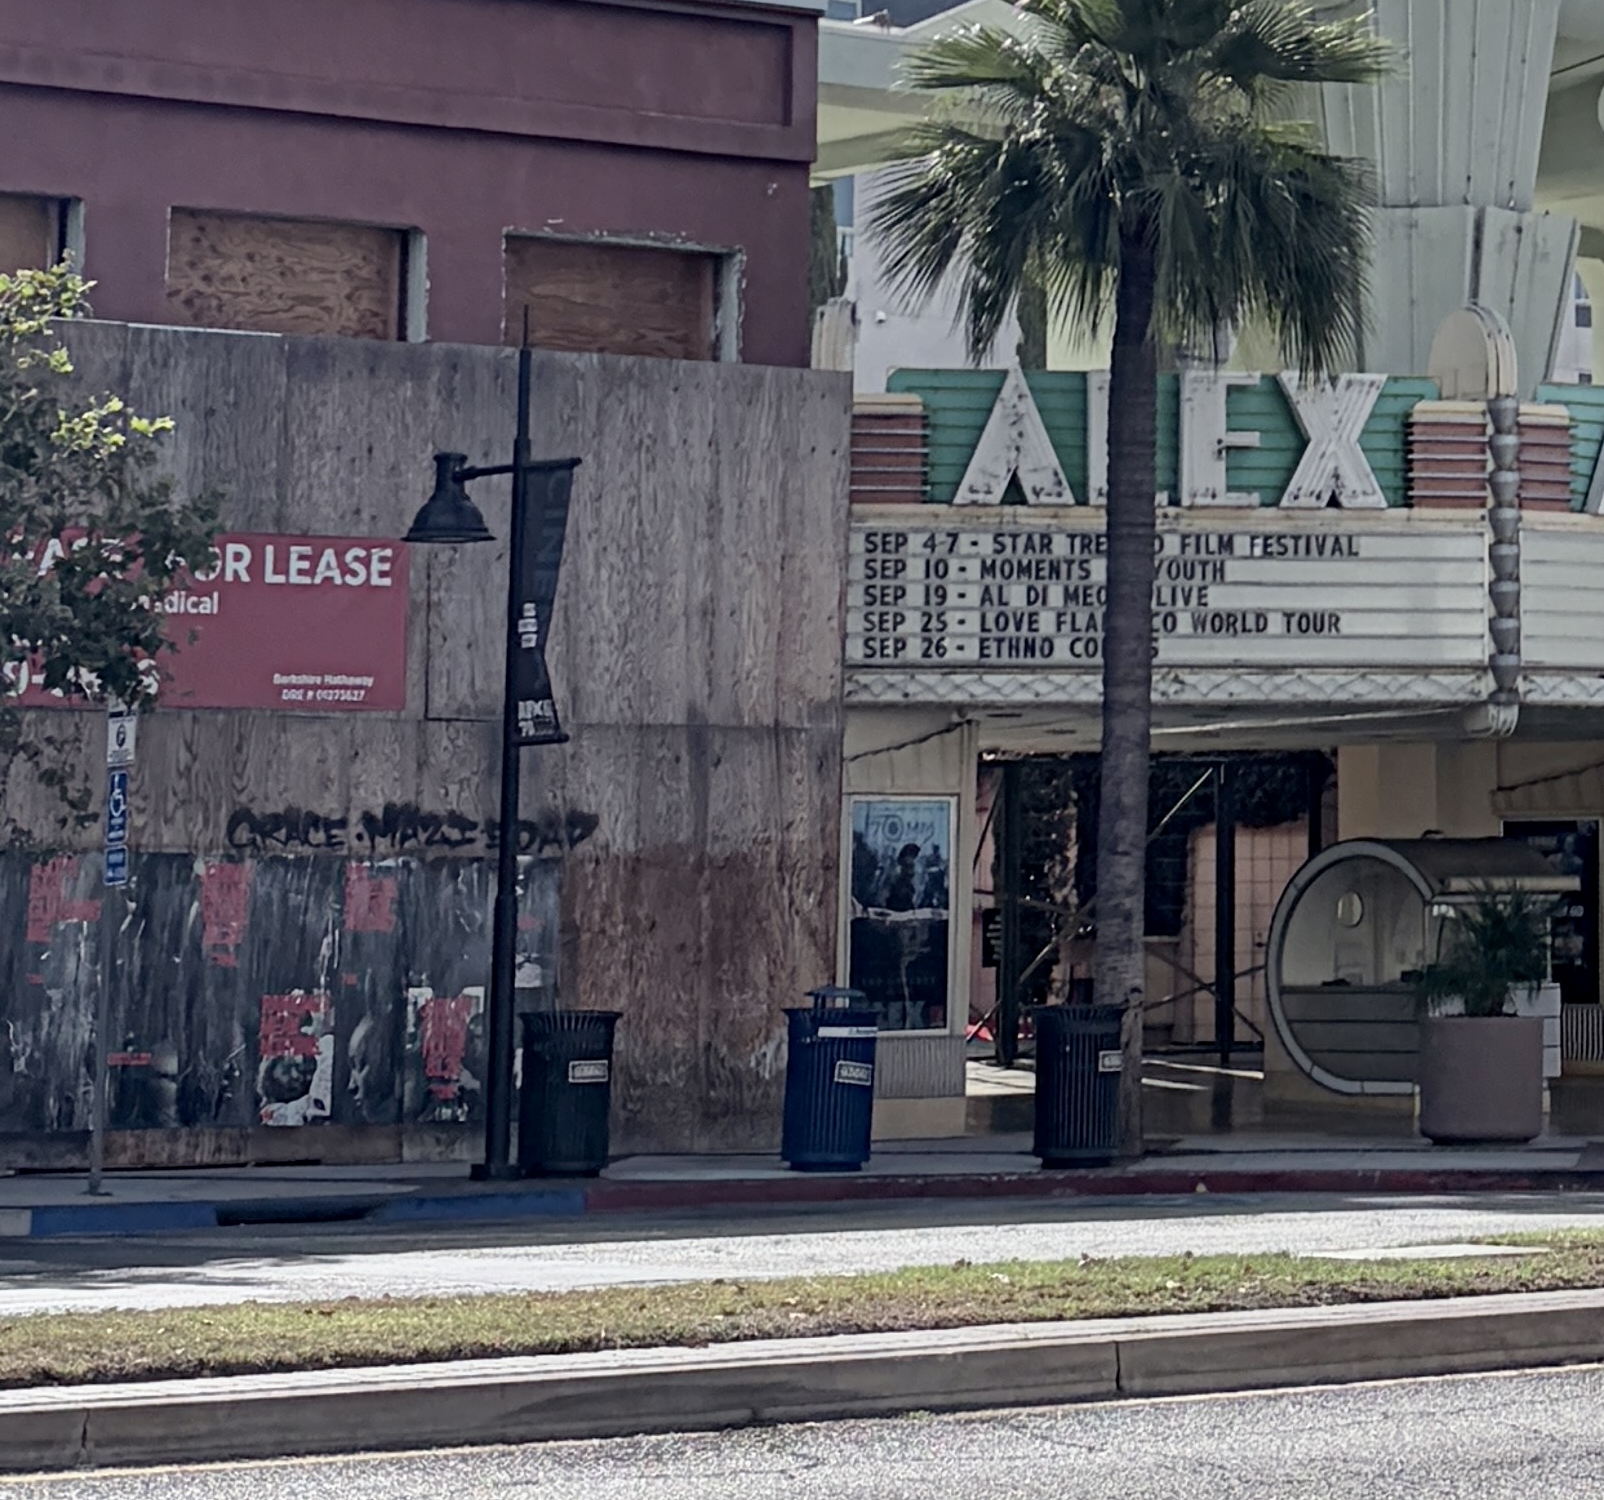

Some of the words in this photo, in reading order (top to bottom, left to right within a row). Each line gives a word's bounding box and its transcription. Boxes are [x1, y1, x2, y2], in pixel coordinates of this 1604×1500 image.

[952, 356, 1388, 509] AEX
[864, 532, 908, 554] SEP
[922, 533, 960, 554] 4-7
[992, 533, 1053, 555] STAR
[1066, 533, 1109, 555] TRE
[1181, 534, 1235, 556] FILM
[1251, 535, 1360, 557] FESTIVAL
[264, 544, 393, 587] LEASE
[864, 558, 907, 580] SEP
[924, 558, 949, 580] 10
[979, 558, 1091, 581] MOMENTS
[863, 584, 907, 606] SEP
[924, 584, 948, 606] 19
[979, 584, 1010, 607] AL
[1026, 585, 1049, 607] DI
[1156, 586, 1209, 608] LIVE
[863, 611, 906, 632] SEP
[920, 611, 948, 633] 25
[980, 612, 1040, 633] LOVE
[1191, 612, 1268, 634] WORLD
[1282, 612, 1341, 634] TOUR
[863, 637, 907, 659] SEP
[921, 637, 948, 659] 26
[979, 638, 1054, 660] ETHNO
